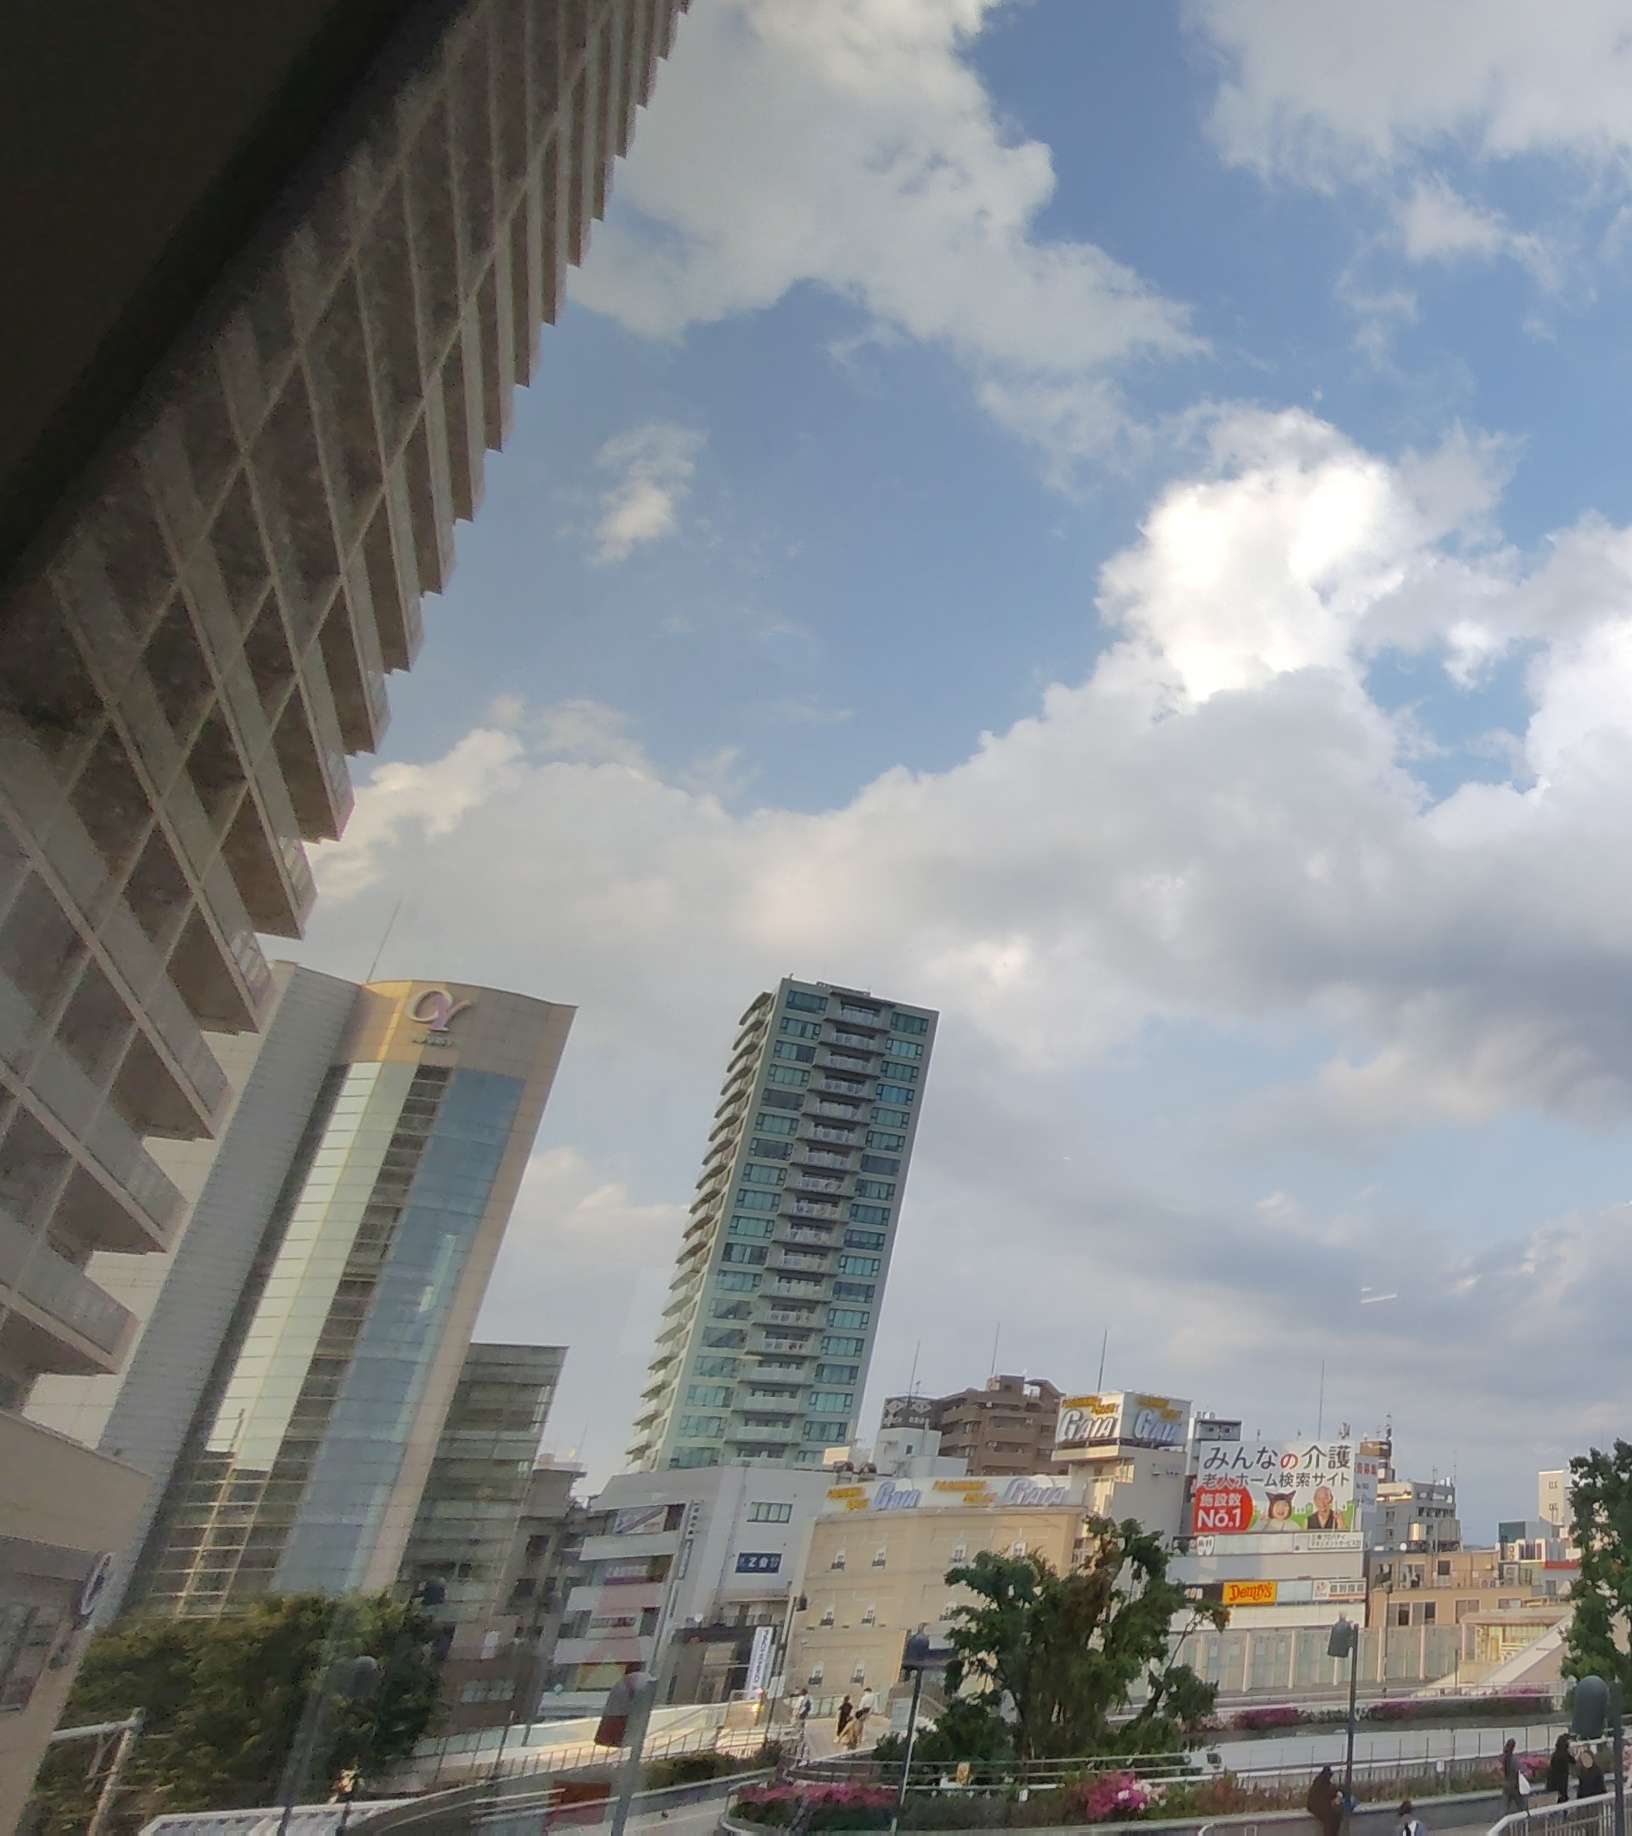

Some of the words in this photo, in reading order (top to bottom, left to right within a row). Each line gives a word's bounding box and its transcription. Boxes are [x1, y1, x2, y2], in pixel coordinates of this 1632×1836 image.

[1203, 1445, 1351, 1470] みんなの介護
[1202, 1473, 1349, 1488] 老人ホーム検索サイト
[1200, 1492, 1242, 1508] 施設数
[1196, 1510, 1241, 1529] No.1
[1229, 1582, 1272, 1601] Denny's
